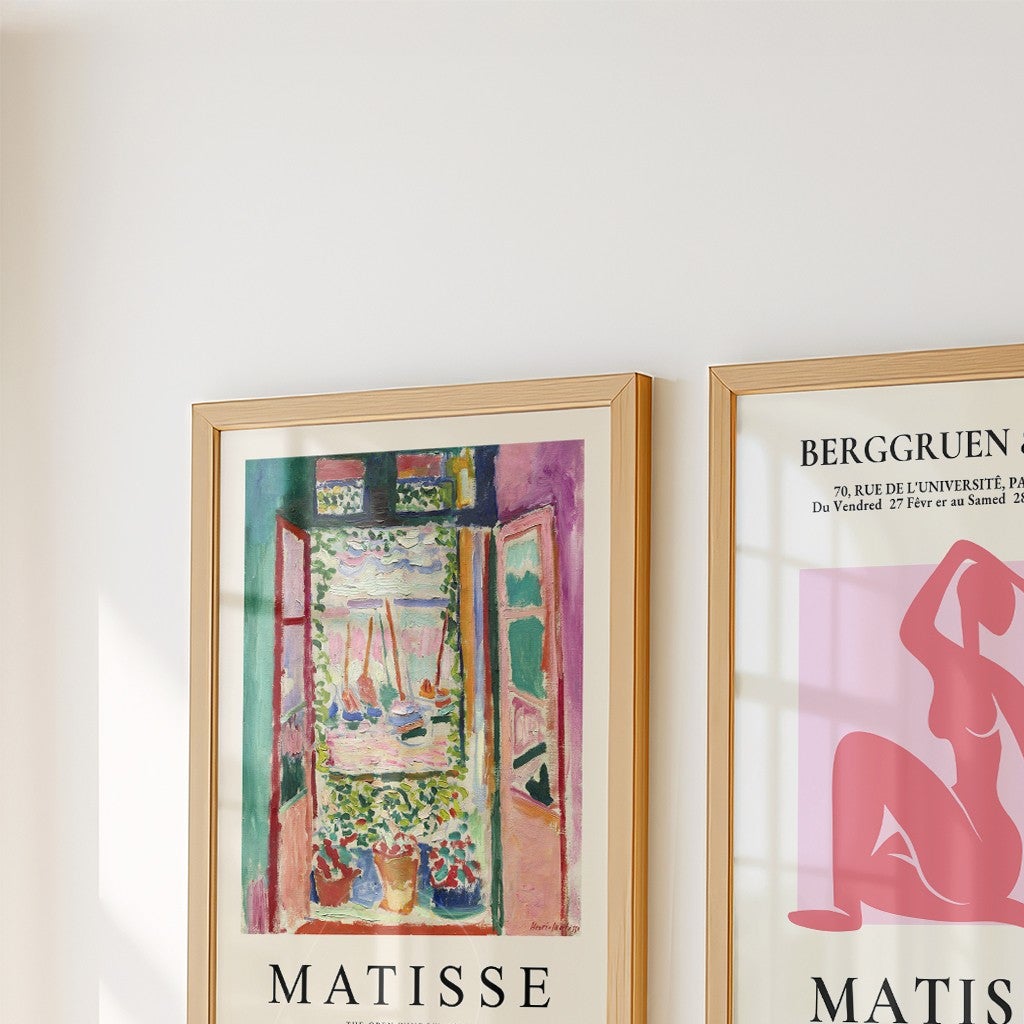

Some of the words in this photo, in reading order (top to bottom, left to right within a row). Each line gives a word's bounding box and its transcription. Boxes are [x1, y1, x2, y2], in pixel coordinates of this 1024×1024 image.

[799, 427, 1011, 467] BERGGRUEN
[811, 501, 831, 514] Du
[832, 498, 883, 513] Vendred
[889, 498, 904, 510] 27
[950, 498, 965, 507] au
[967, 492, 1007, 506] Samed
[833, 485, 852, 499] 70,
[854, 483, 883, 497] RUE
[885, 482, 905, 495] DE
[267, 963, 551, 1009] MATISSE
